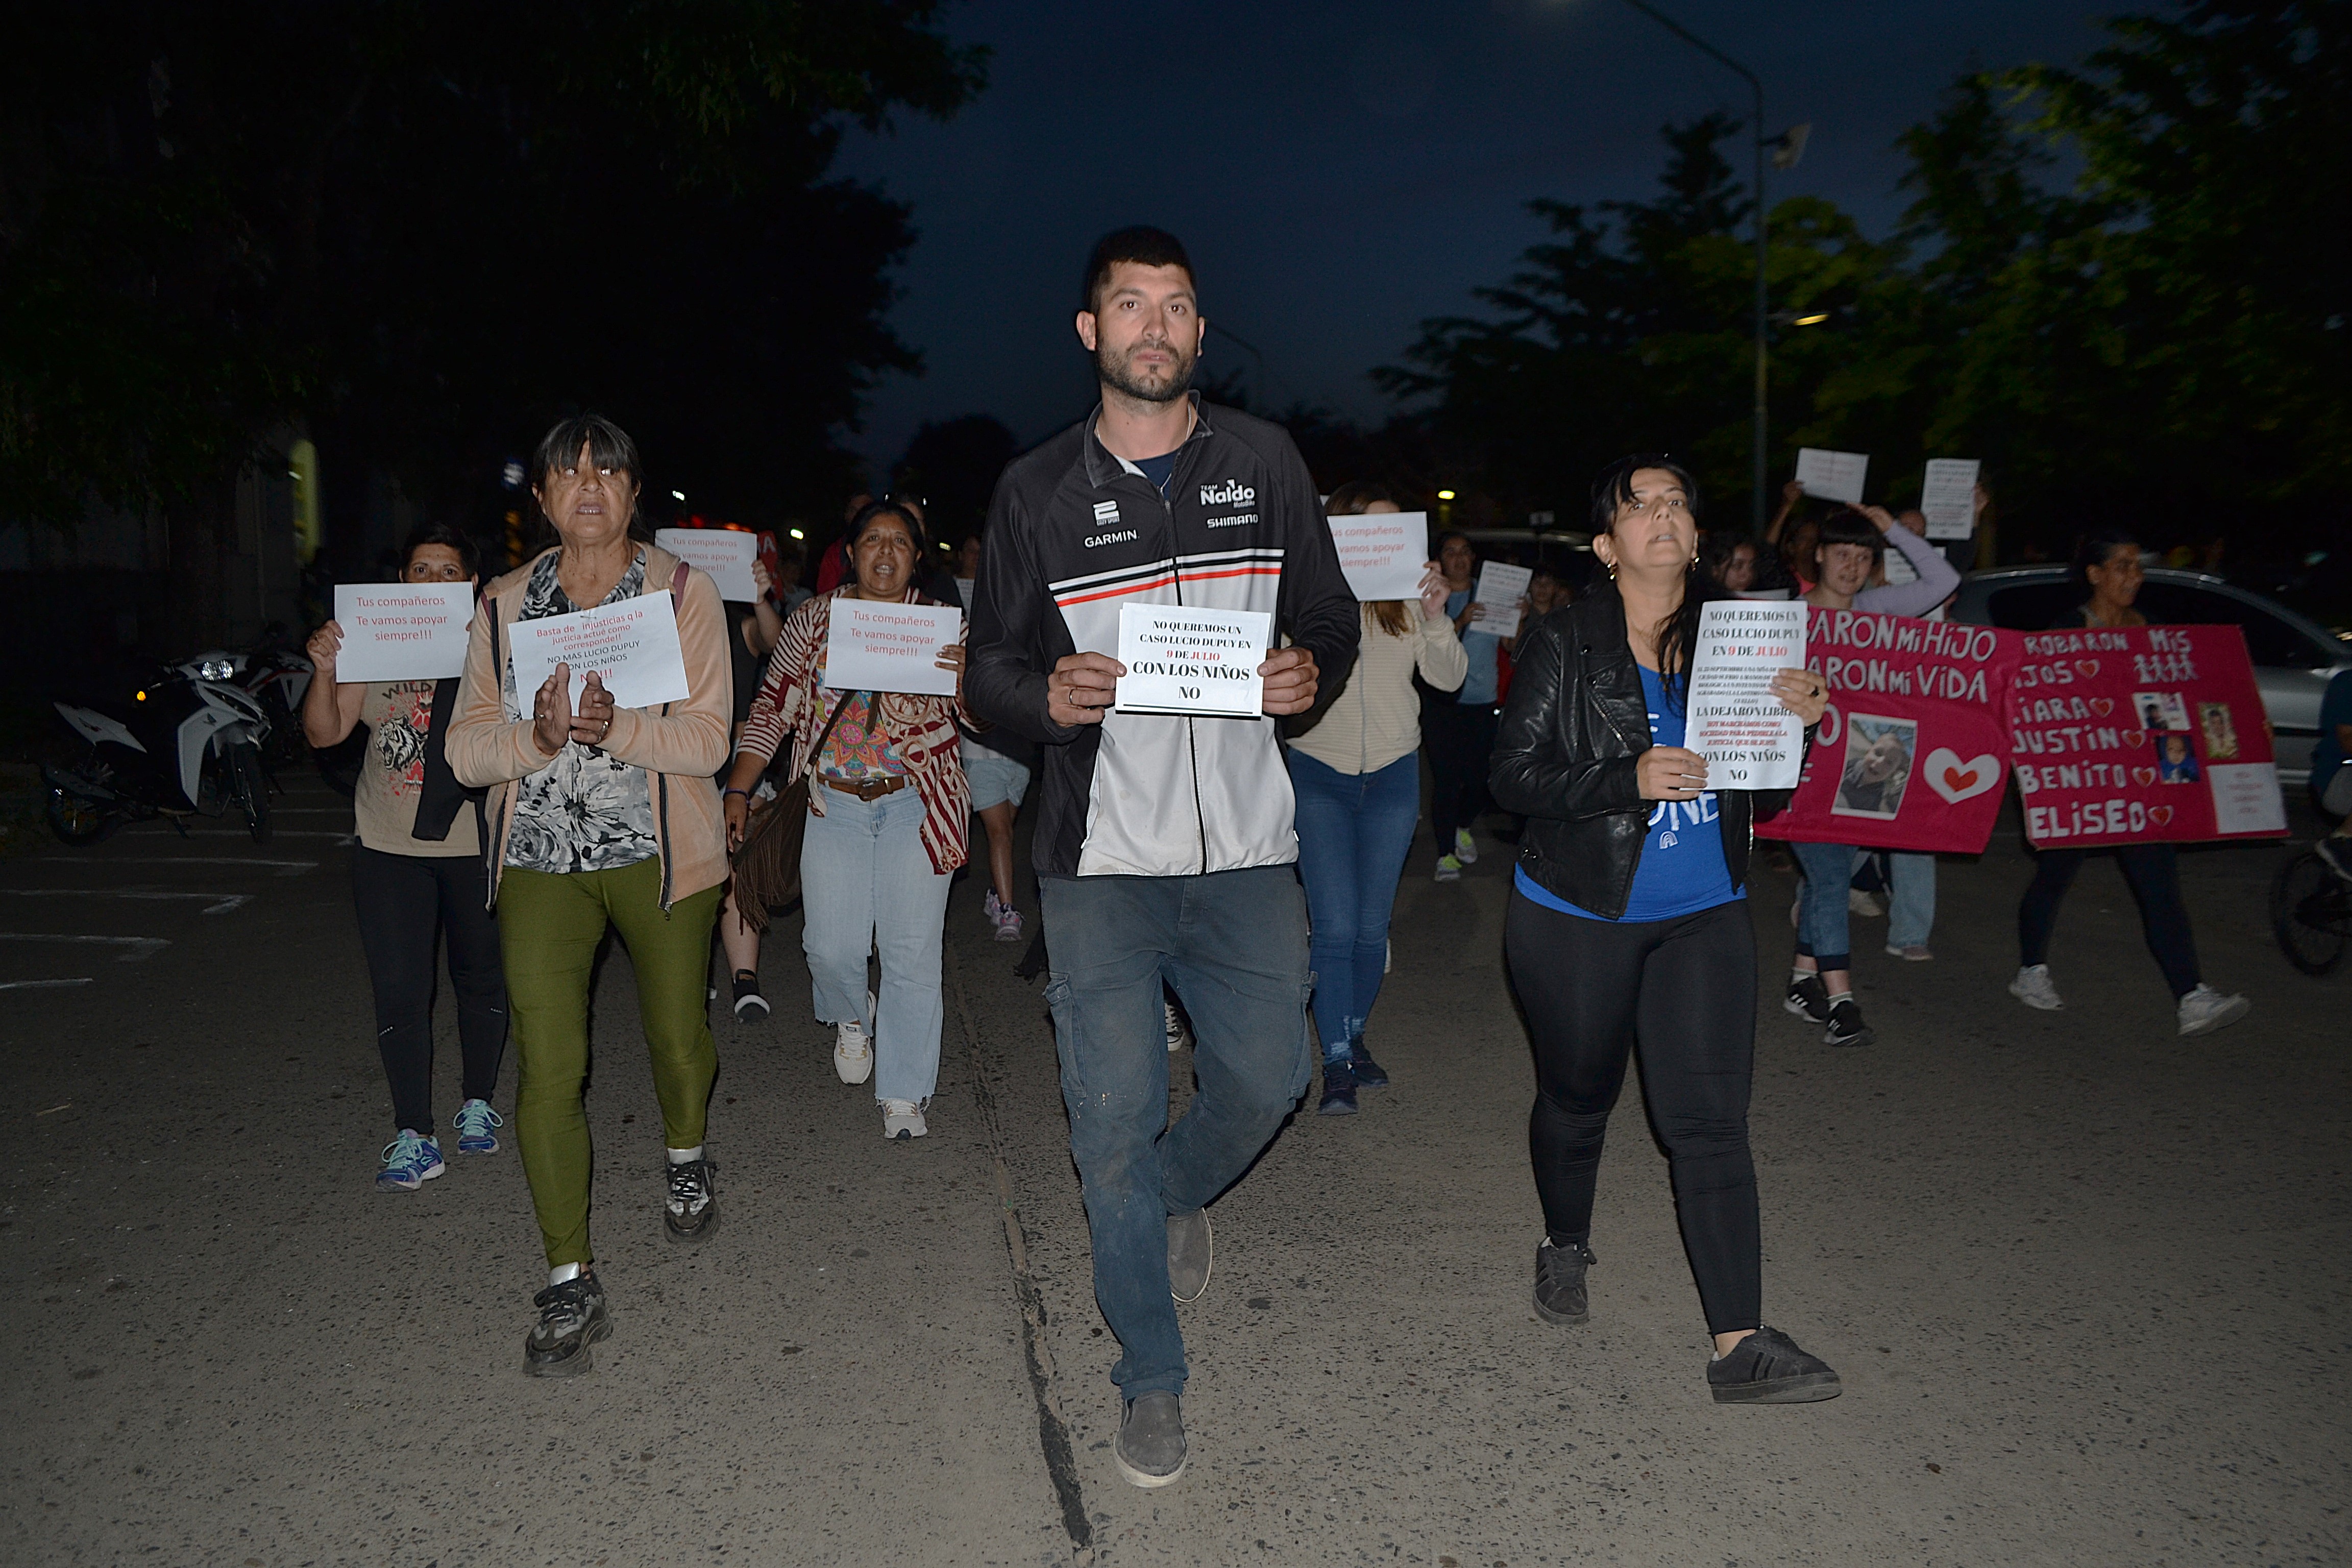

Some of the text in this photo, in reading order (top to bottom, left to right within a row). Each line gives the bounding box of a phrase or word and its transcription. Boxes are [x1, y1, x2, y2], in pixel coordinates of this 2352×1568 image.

[1200, 485, 1255, 505] Naldo
[1207, 513, 1259, 529] SHIMANO
[1085, 529, 1138, 548] GARMIN
[1345, 526, 1404, 537] compañeros
[688, 538, 738, 548] compañeros
[1339, 543, 1405, 553] vamos apoyar
[710, 553, 739, 562] apoyar
[1341, 556, 1390, 568] siempre!!!
[356, 596, 446, 608] Tus compañeros
[356, 616, 448, 626] Te vamos apoyar
[853, 610, 936, 628] Tus compañeros
[1710, 610, 1798, 623] NO QUEREMOS UN
[536, 610, 643, 638] Basta de injusticias q la
[1153, 620, 1242, 634] NO QUEREMOS UN
[375, 630, 432, 642] siempre!!!
[552, 625, 631, 645] justicia actué como
[850, 628, 935, 645] Te vamos apoyar
[1703, 628, 1800, 639] CASO LUCIO DUPUY
[564, 633, 622, 651] corresponde!!
[1140, 633, 1252, 649] CASO LUCIO DUPUY EN
[2023, 632, 2129, 657] ROBARON
[547, 640, 641, 664] NO MAS LUCIO DUPUY
[865, 644, 918, 657] siempre!!!
[1166, 649, 1220, 661] 9 DE JULIO
[1712, 645, 1788, 656] EN 9 DE JULIO
[569, 653, 628, 671] ON LOS NIÑOS
[580, 668, 613, 683] N!!!
[1133, 660, 1250, 681] CON LOS NIÑOS
[1806, 655, 1889, 693] ARON
[382, 682, 433, 699] WILD
[1178, 686, 1200, 700] NO
[1697, 706, 1710, 717] LA
[1711, 706, 1761, 717] DEJARON
[1721, 750, 1746, 762] LOS
[1749, 749, 1786, 762] NIÑOS
[1728, 769, 1747, 780] NO
